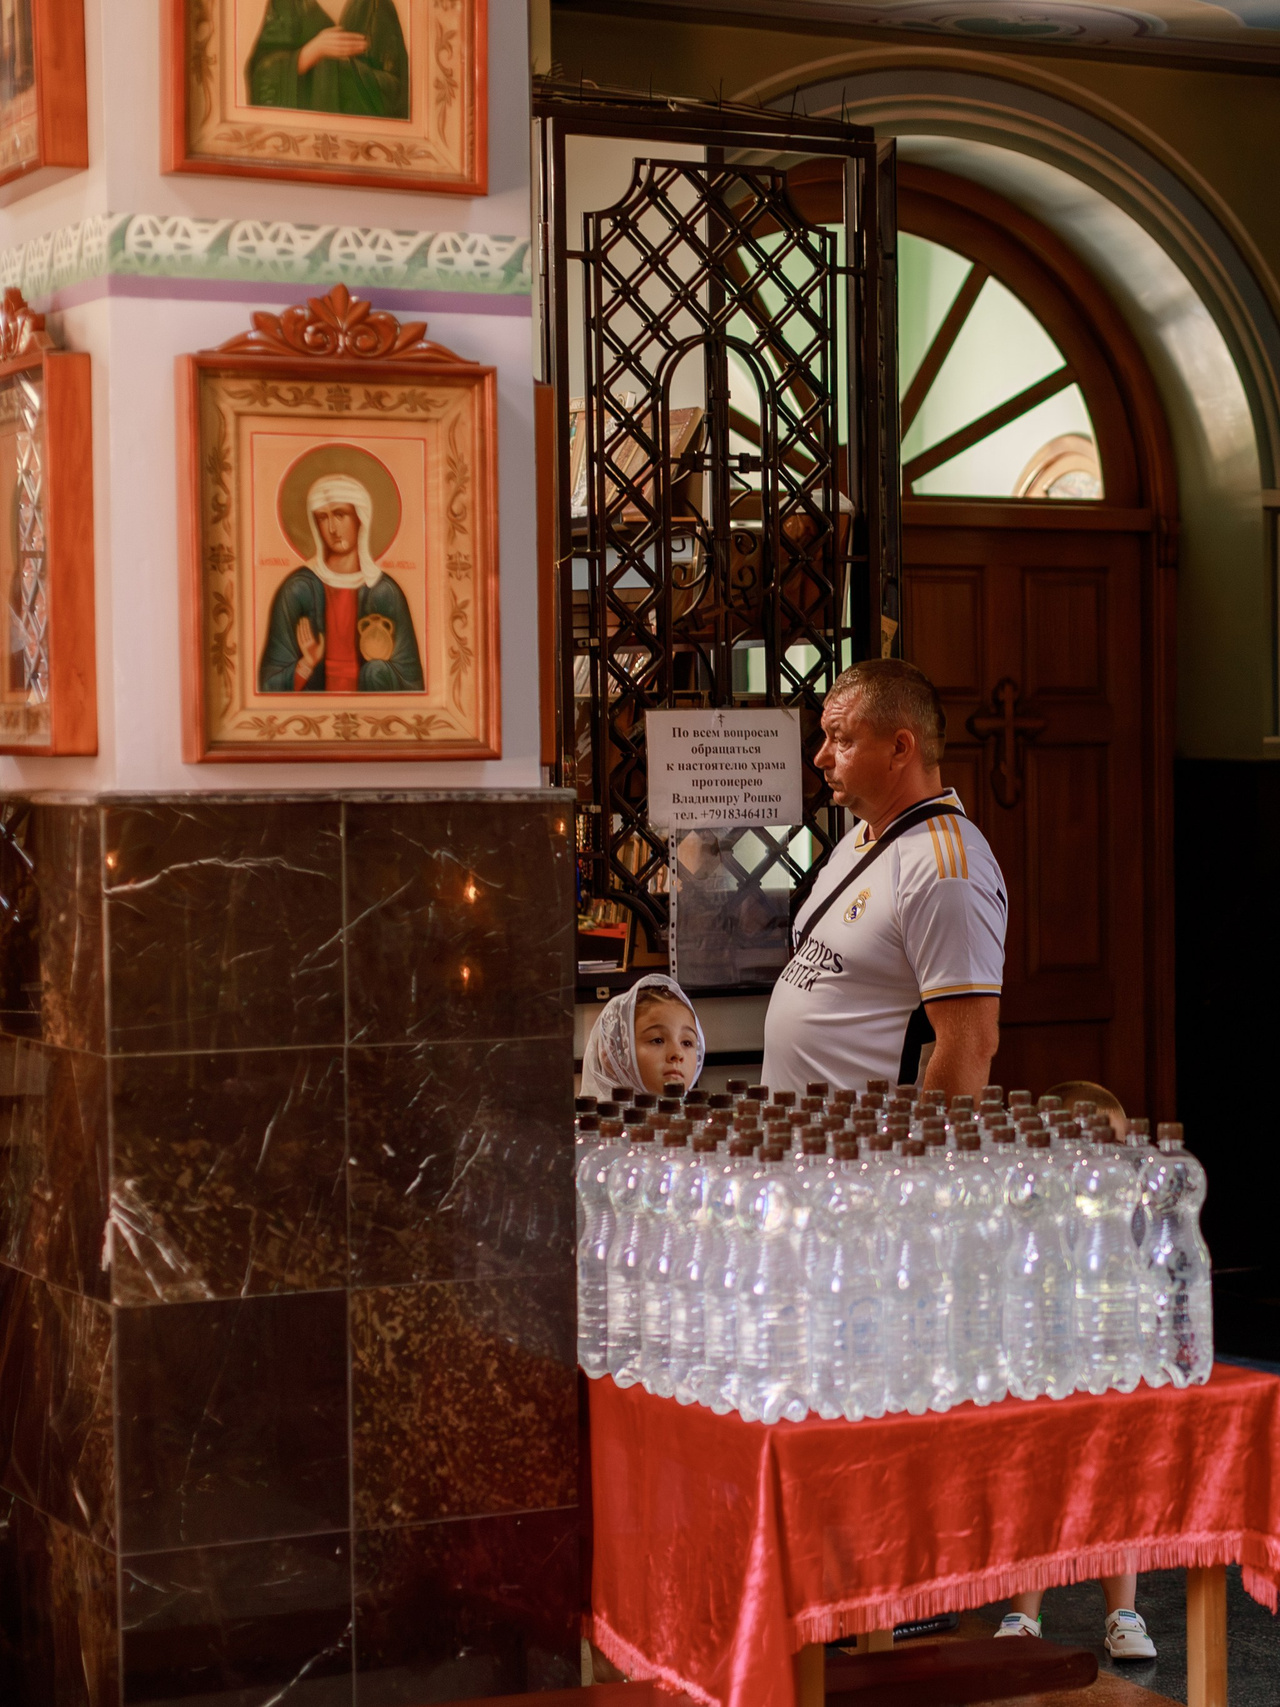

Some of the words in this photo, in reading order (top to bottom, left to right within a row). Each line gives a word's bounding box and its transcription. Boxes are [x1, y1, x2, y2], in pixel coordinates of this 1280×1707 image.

[672, 727, 689, 738] По
[693, 729, 720, 738] всем
[723, 729, 778, 740] вопросам
[691, 744, 761, 757] обращаться
[666, 763, 674, 771] к
[678, 762, 748, 771] настоятелю
[751, 762, 786, 773] храма
[692, 778, 763, 790] протоиерею
[672, 793, 739, 806] Владимиру
[743, 793, 782, 803] Рошко
[673, 812, 698, 820] тел.
[701, 808, 778, 819] +79183464131
